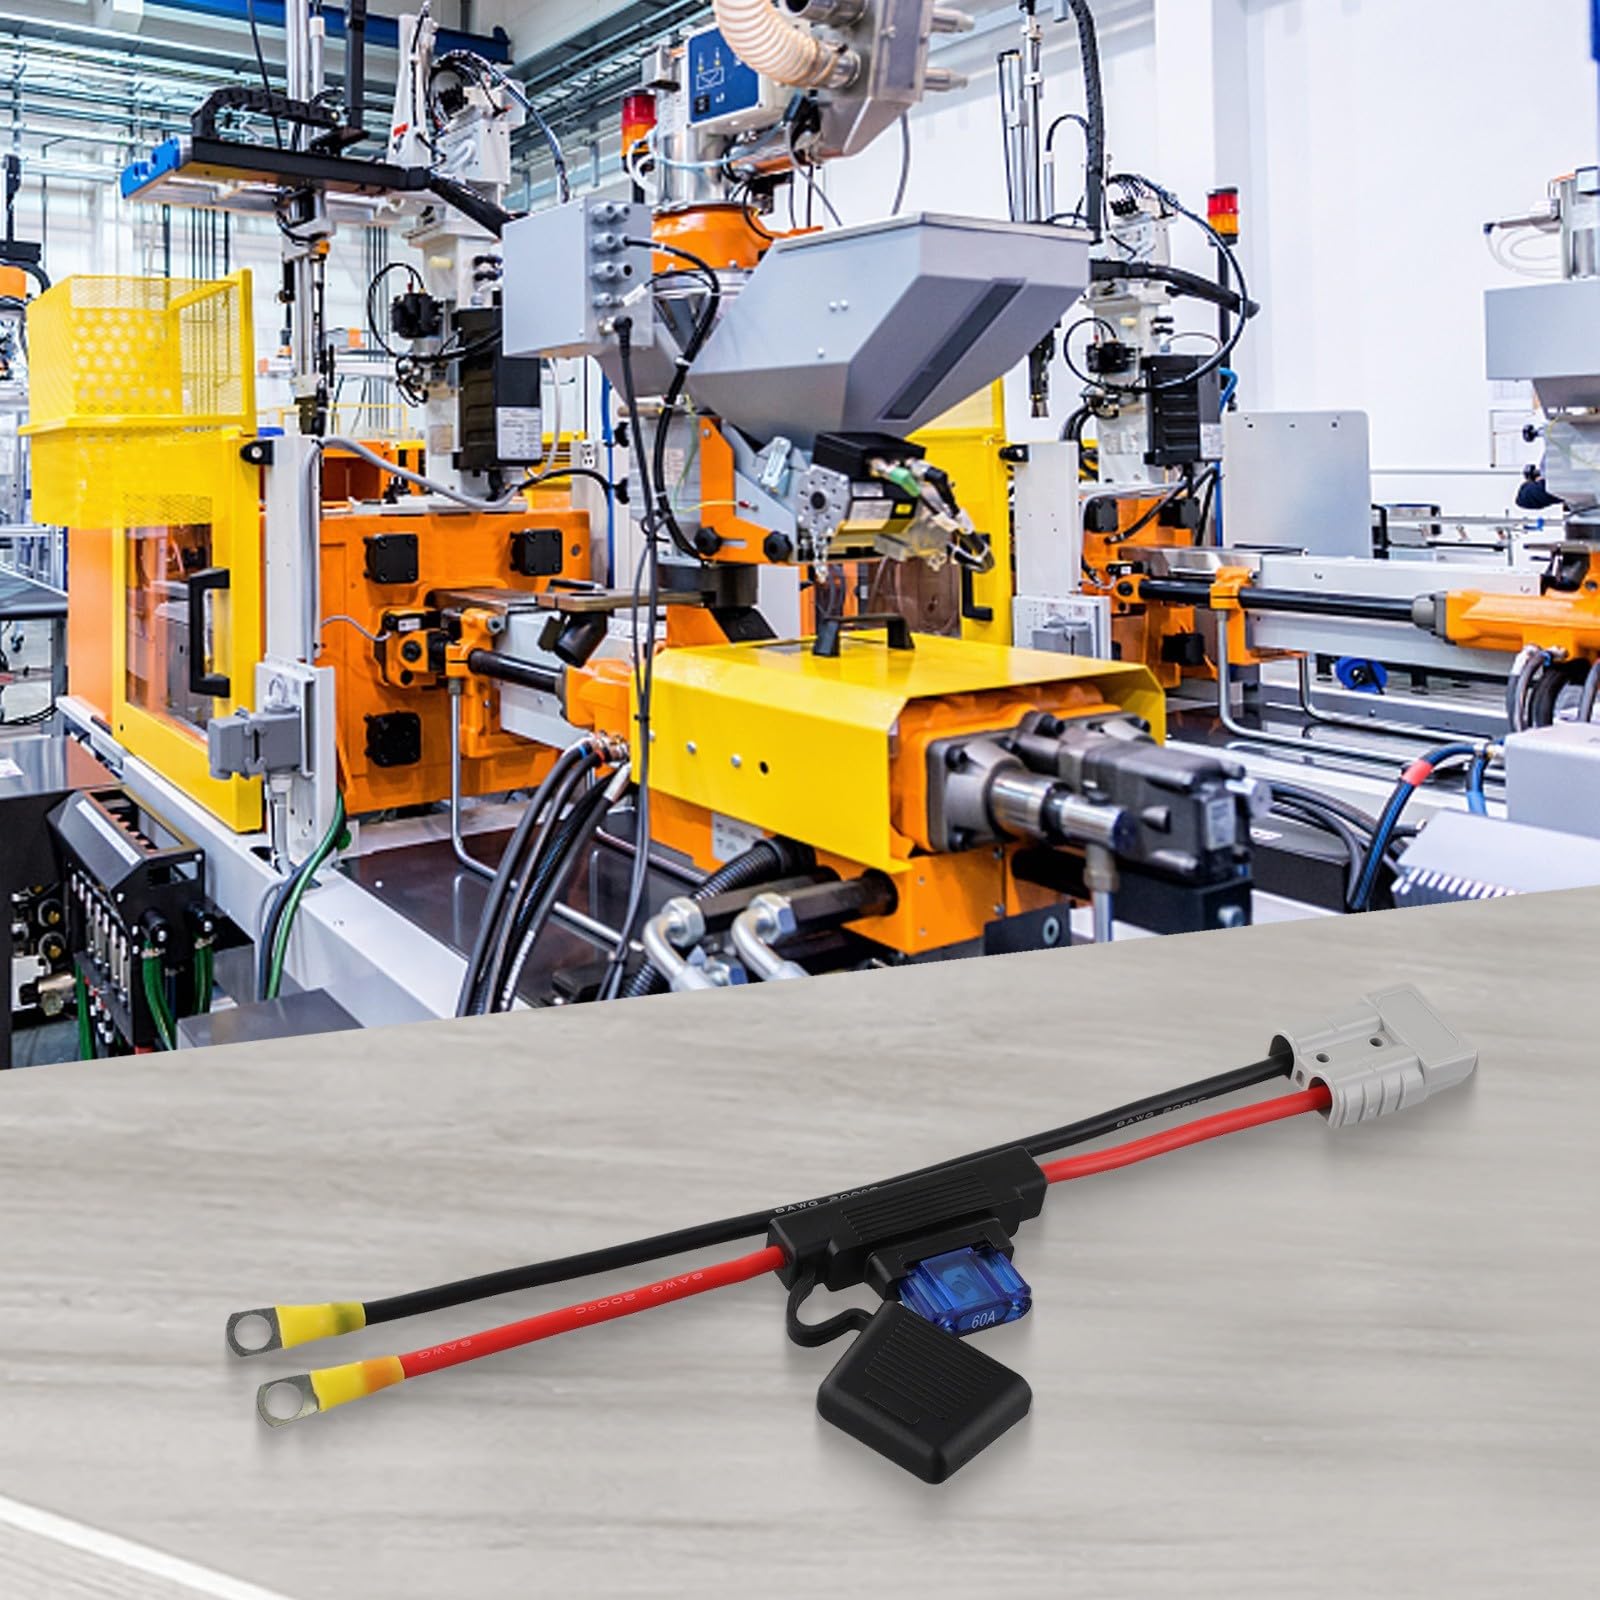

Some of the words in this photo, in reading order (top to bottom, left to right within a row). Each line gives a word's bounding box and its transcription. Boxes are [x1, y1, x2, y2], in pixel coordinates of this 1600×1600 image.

[774, 1200, 819, 1214] 8AWG
[651, 1272, 703, 1293] 8AWG
[971, 1310, 996, 1330] 60A
[418, 1339, 472, 1359] 8AWG
